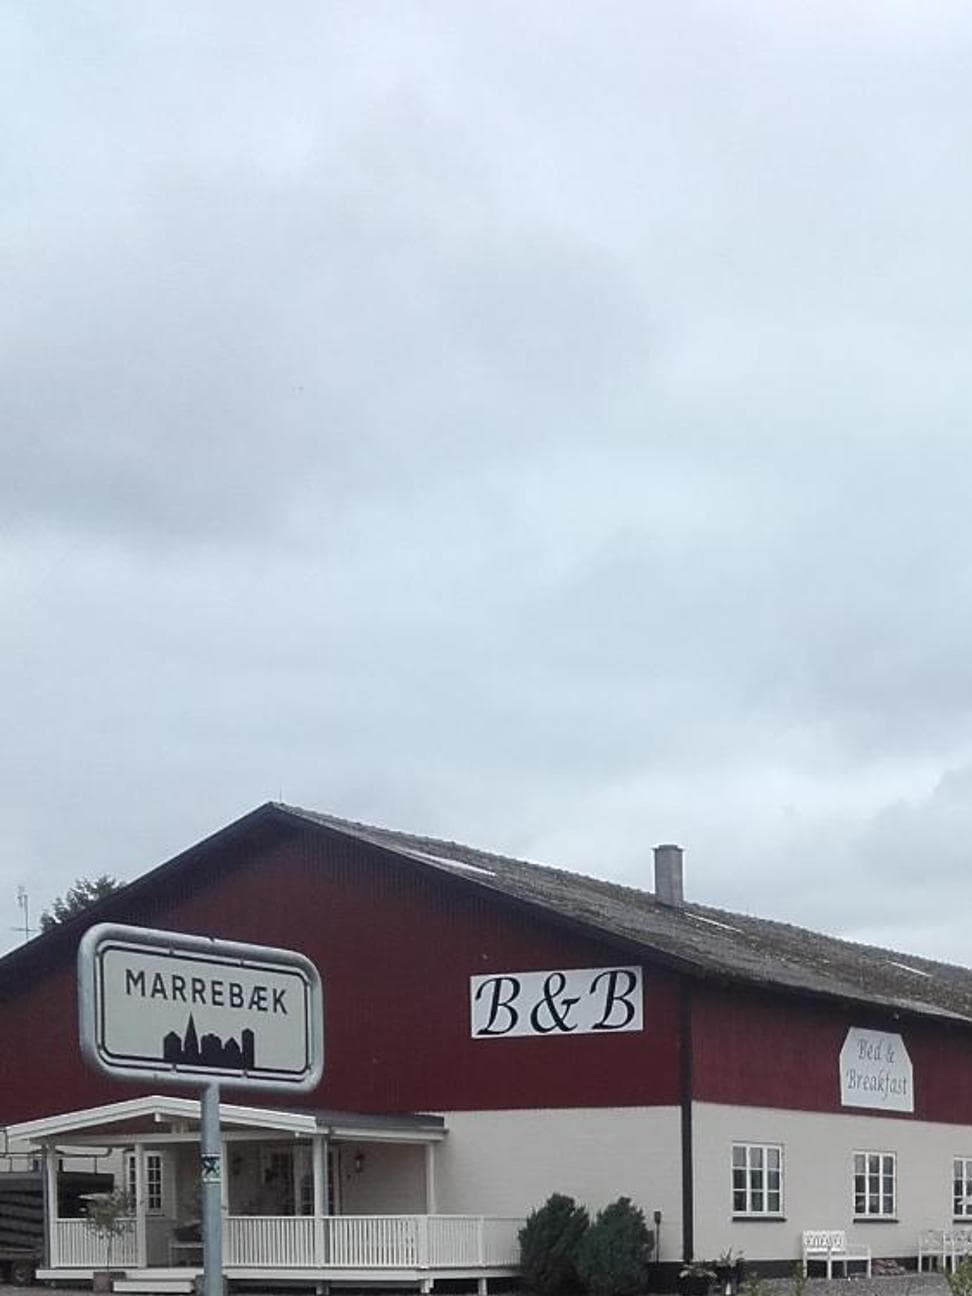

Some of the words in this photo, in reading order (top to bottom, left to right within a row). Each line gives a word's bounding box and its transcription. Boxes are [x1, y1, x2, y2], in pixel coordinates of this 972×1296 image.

[125, 968, 288, 1015] MARREBÆK
[857, 1039, 883, 1061] Bed
[846, 1068, 907, 1101] Breakfast
